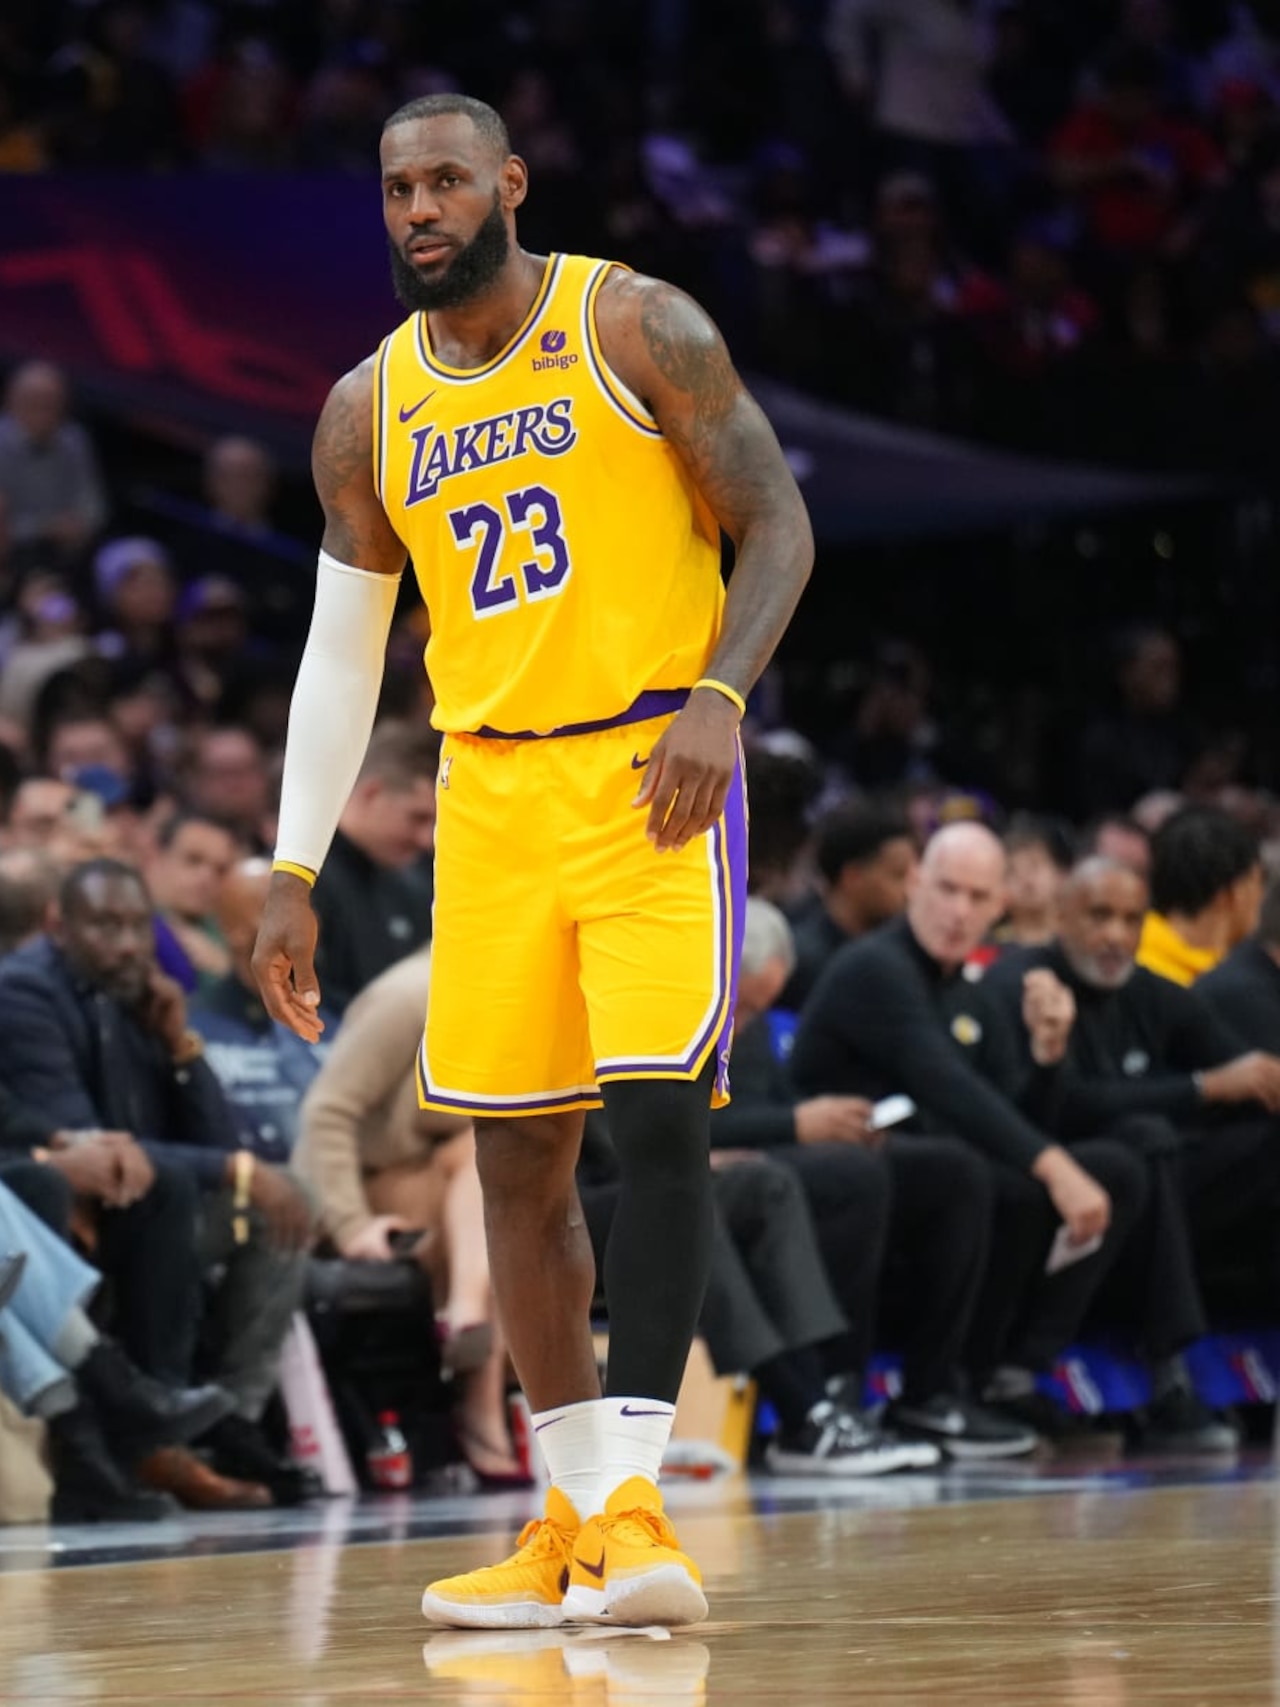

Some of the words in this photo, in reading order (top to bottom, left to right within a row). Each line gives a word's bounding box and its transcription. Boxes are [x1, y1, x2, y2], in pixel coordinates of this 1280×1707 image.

[532, 353, 579, 378] bibigo
[404, 398, 577, 509] LAKERS
[448, 484, 572, 621] 23
